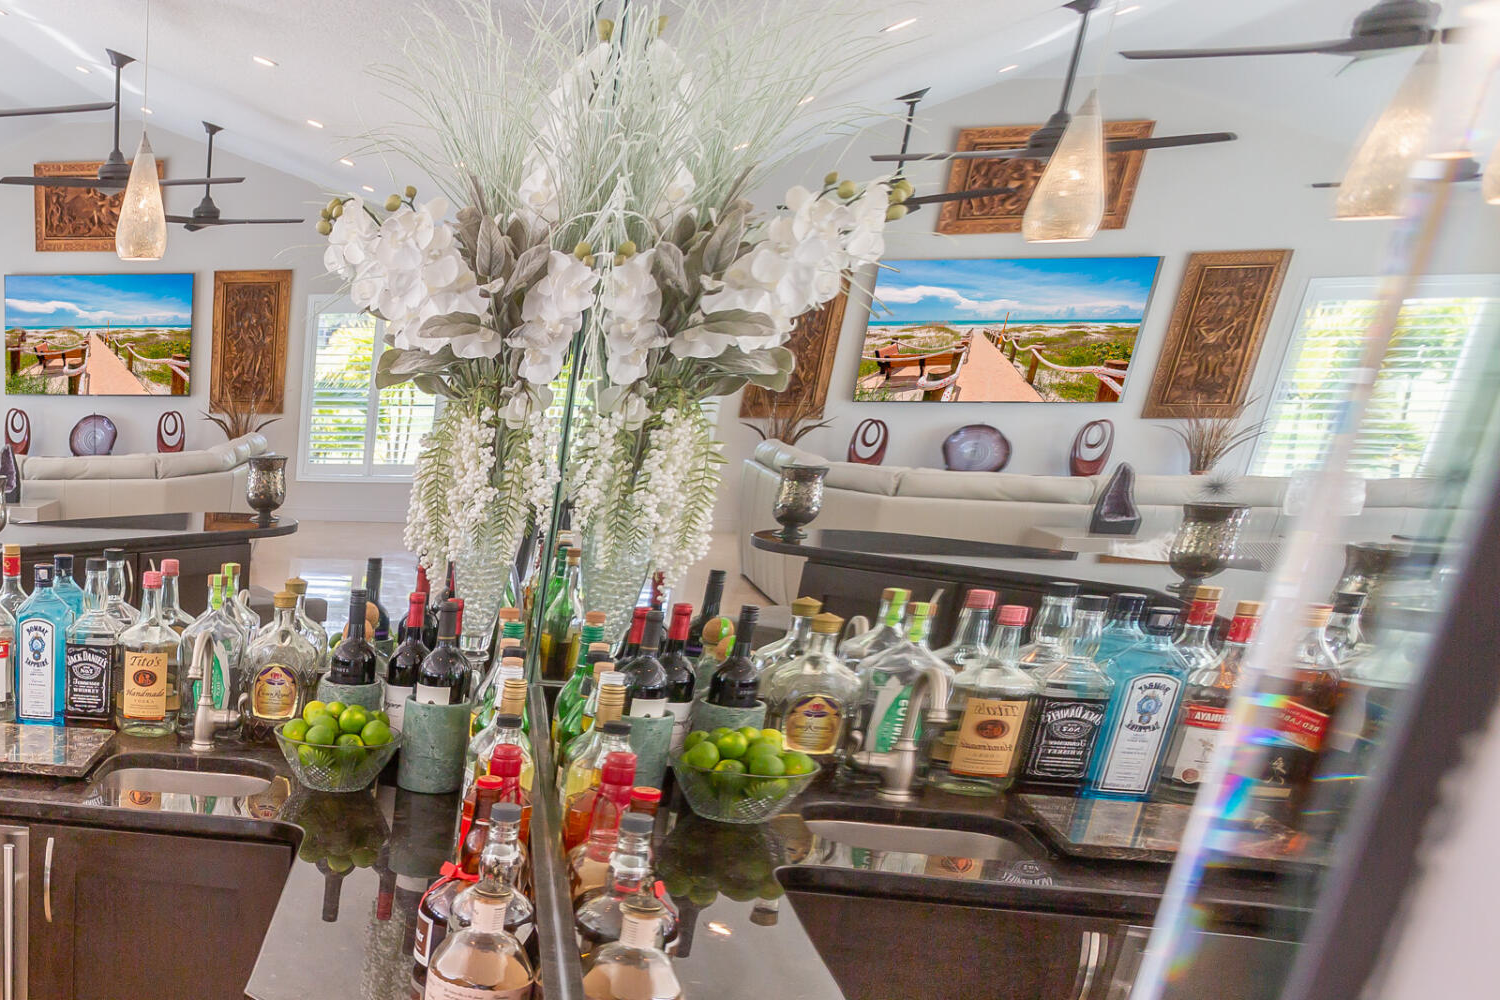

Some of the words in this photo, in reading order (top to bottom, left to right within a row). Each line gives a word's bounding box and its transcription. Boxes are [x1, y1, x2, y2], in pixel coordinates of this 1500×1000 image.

[26, 624, 49, 636] BOMBAY
[67, 653, 82, 667] JACK
[82, 650, 108, 669] DANIEL'S
[130, 655, 162, 667] Tito's
[126, 687, 165, 698] Handmade
